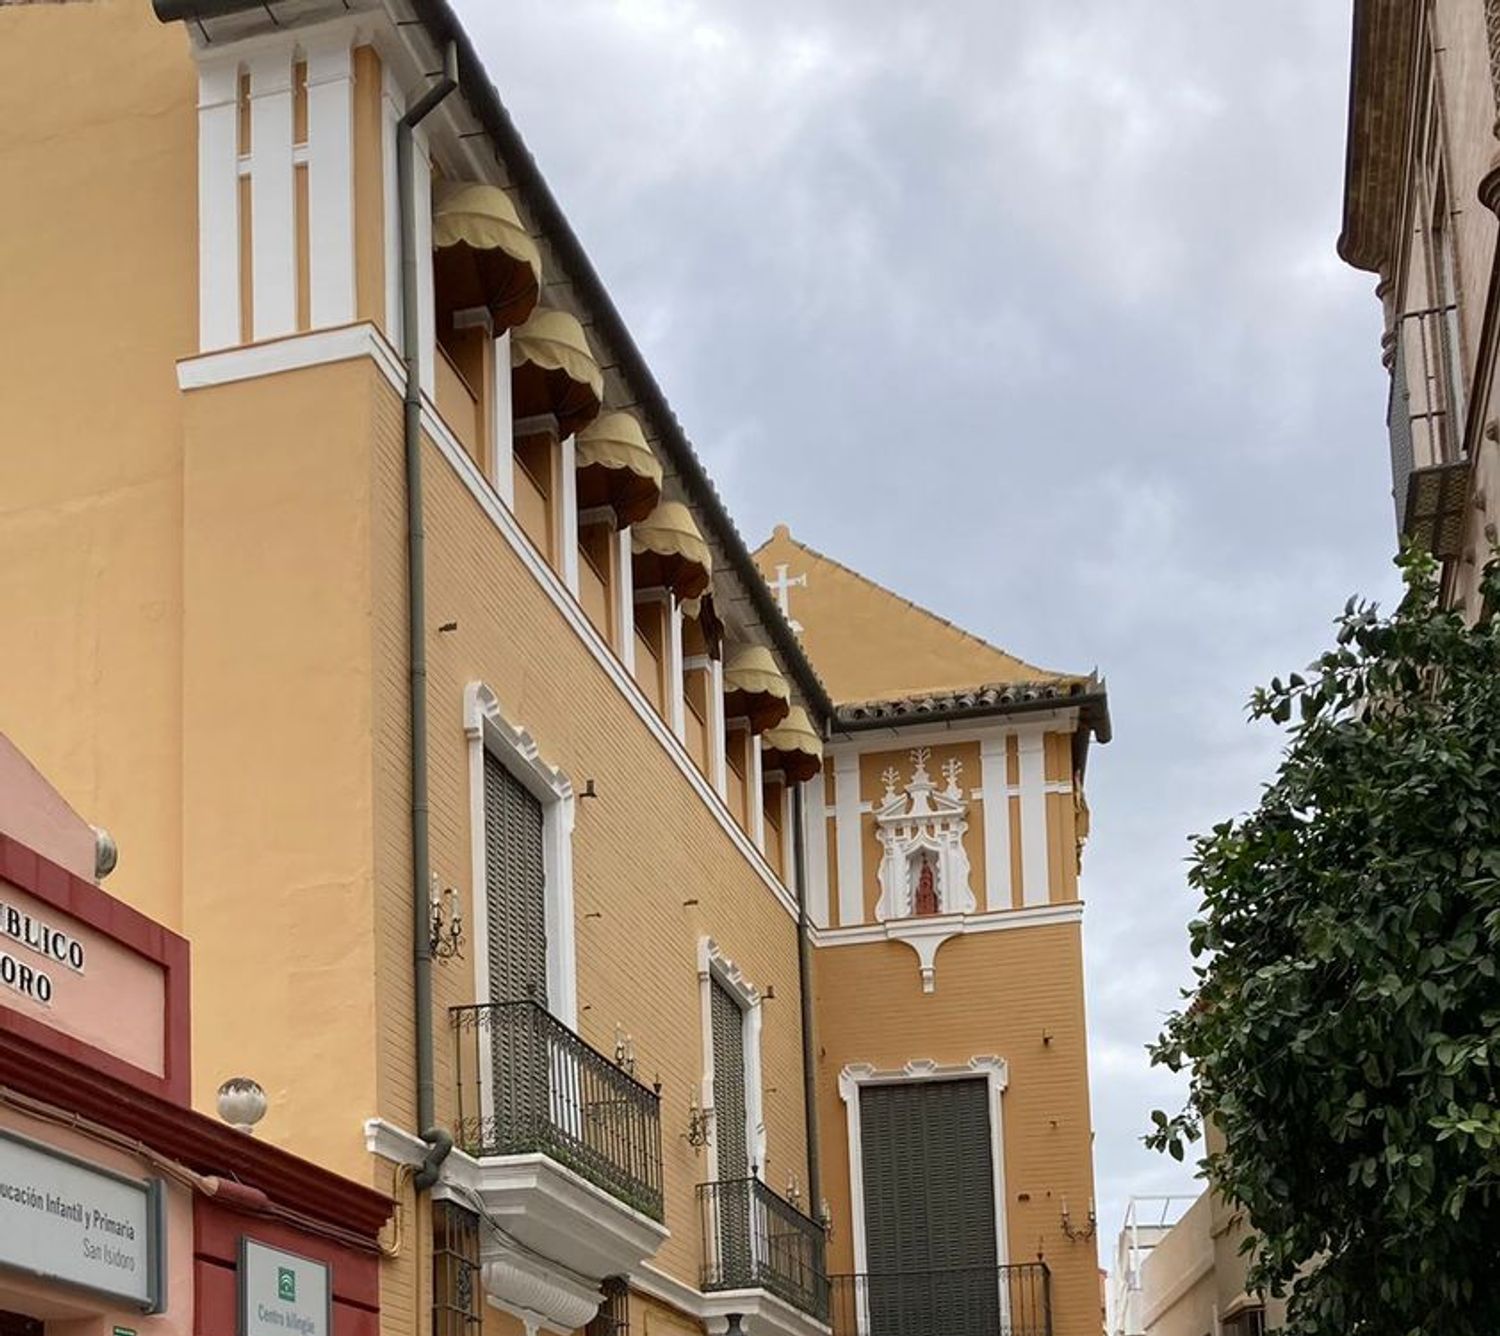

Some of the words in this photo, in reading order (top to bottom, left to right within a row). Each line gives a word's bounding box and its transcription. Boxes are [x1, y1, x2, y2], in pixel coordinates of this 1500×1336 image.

[0, 904, 83, 968] BLICO
[46, 1193, 83, 1222] Infantil
[85, 1211, 91, 1230] y
[93, 1209, 135, 1240] Primaria
[83, 1237, 102, 1261] San
[104, 1243, 136, 1272] Isidoro
